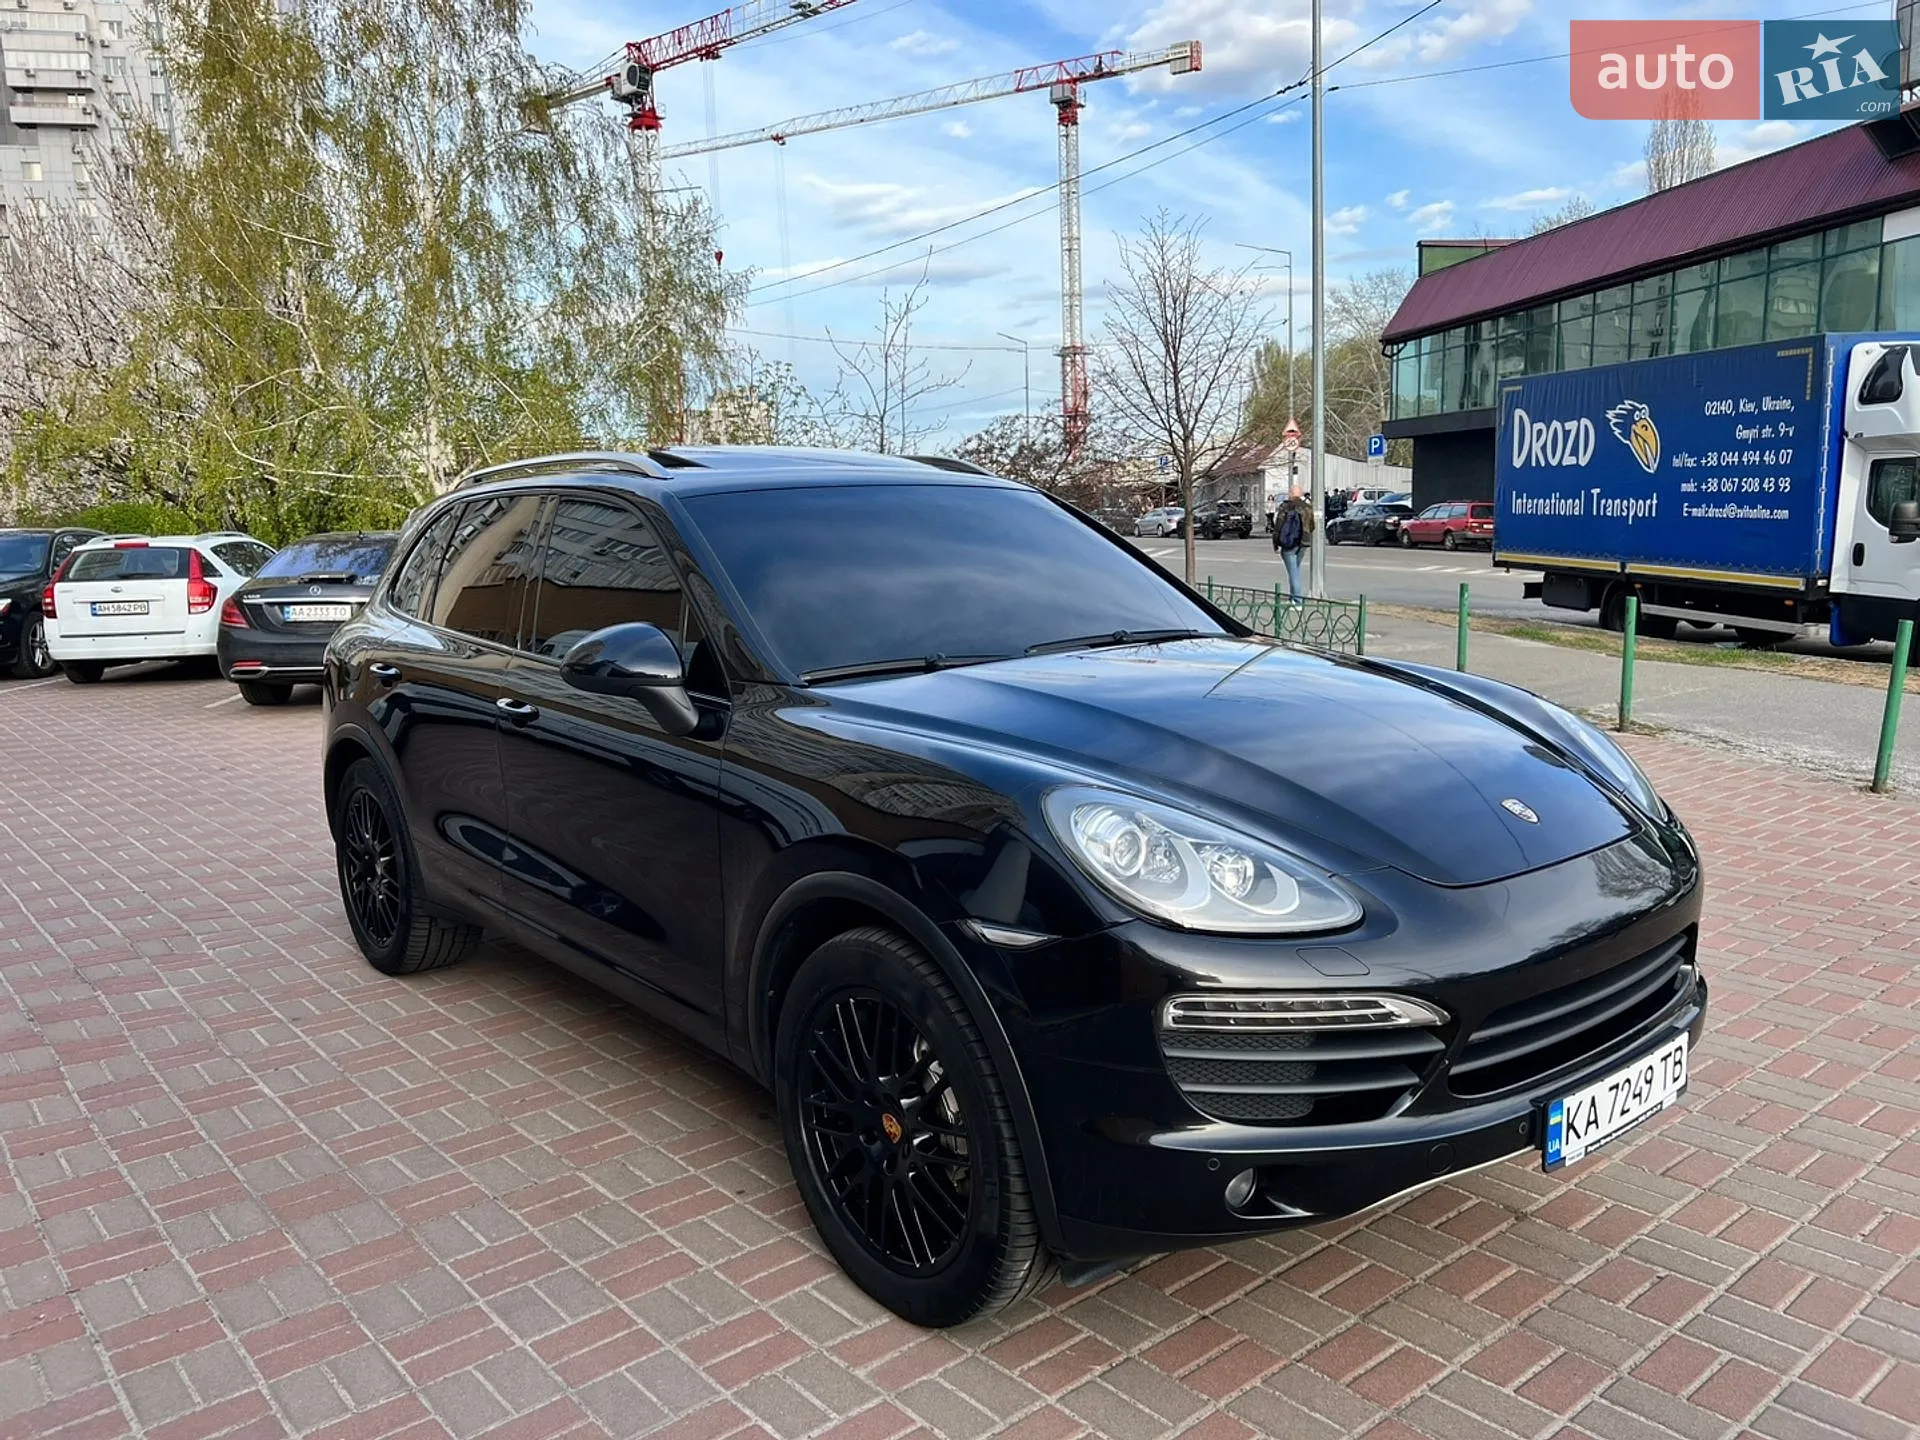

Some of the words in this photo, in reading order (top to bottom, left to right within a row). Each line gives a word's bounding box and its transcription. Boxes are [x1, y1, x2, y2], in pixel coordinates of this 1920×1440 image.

[1704, 399, 1735, 416] 02140,
[1739, 398, 1758, 414] Kiev,
[1762, 396, 1794, 412] Ukraine,
[1512, 408, 1595, 469] DROZD
[1735, 424, 1759, 444] Gmyri
[1761, 424, 1775, 438] str.
[1779, 421, 1794, 437] 9-v
[1371, 438, 1380, 453] P
[1700, 451, 1718, 466] +38
[1721, 451, 1739, 466] 044
[1742, 450, 1760, 465] 494
[1763, 449, 1776, 465] 46
[1779, 449, 1793, 464] 07
[1681, 479, 1697, 492] mob:
[1700, 478, 1718, 492] +38
[1721, 478, 1739, 492] 067
[1741, 477, 1760, 492] 508
[1763, 477, 1775, 492] 43
[1778, 477, 1791, 492] 93
[1512, 490, 1584, 517] International
[1591, 488, 1658, 525] Transport
[291, 606, 305, 617] AA
[331, 607, 347, 617] TO
[1565, 1095, 1599, 1146] KA
[1608, 1064, 1654, 1124] 7249
[1660, 1045, 1683, 1091] TB
[1548, 1138, 1561, 1153] UA
